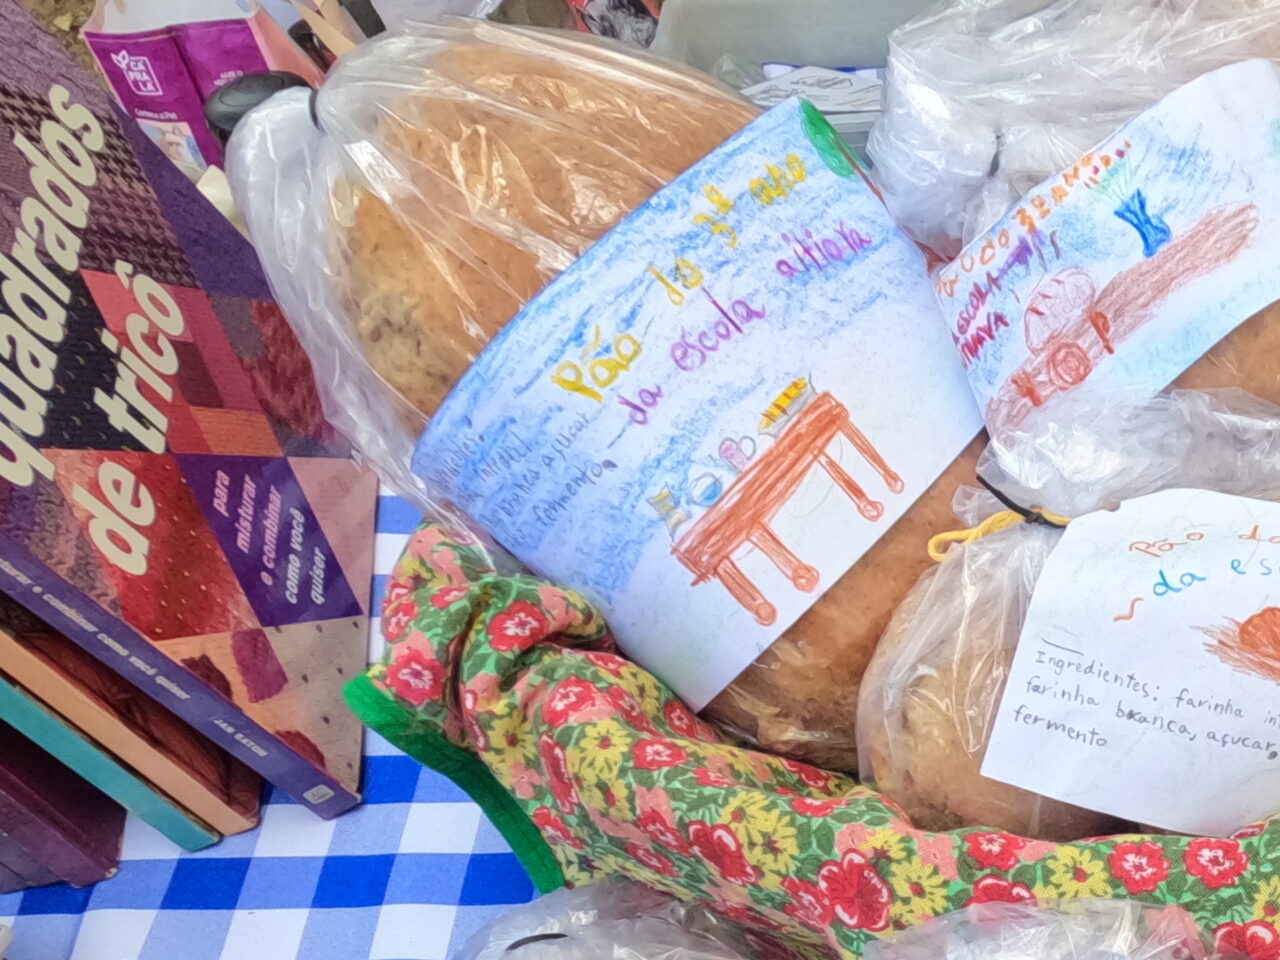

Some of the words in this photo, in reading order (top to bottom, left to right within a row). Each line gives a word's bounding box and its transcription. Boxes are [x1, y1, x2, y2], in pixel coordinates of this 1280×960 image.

[92, 258, 185, 455] tricô
[550, 324, 642, 403] Pão
[617, 384, 664, 426] da
[670, 286, 767, 371] escola
[72, 460, 156, 576] de
[212, 468, 231, 518] para
[234, 473, 257, 554] misturar
[261, 483, 282, 569] combinar
[289, 507, 305, 552] você
[260, 570, 273, 586] e
[284, 553, 301, 604] como
[310, 545, 326, 605] quiser
[1152, 568, 1207, 597] da
[96, 632, 130, 656] como
[1025, 675, 1101, 707] farinha
[1034, 650, 1161, 702] Ingredientes:
[1174, 687, 1246, 720] farinha
[1012, 703, 1108, 747] fermento
